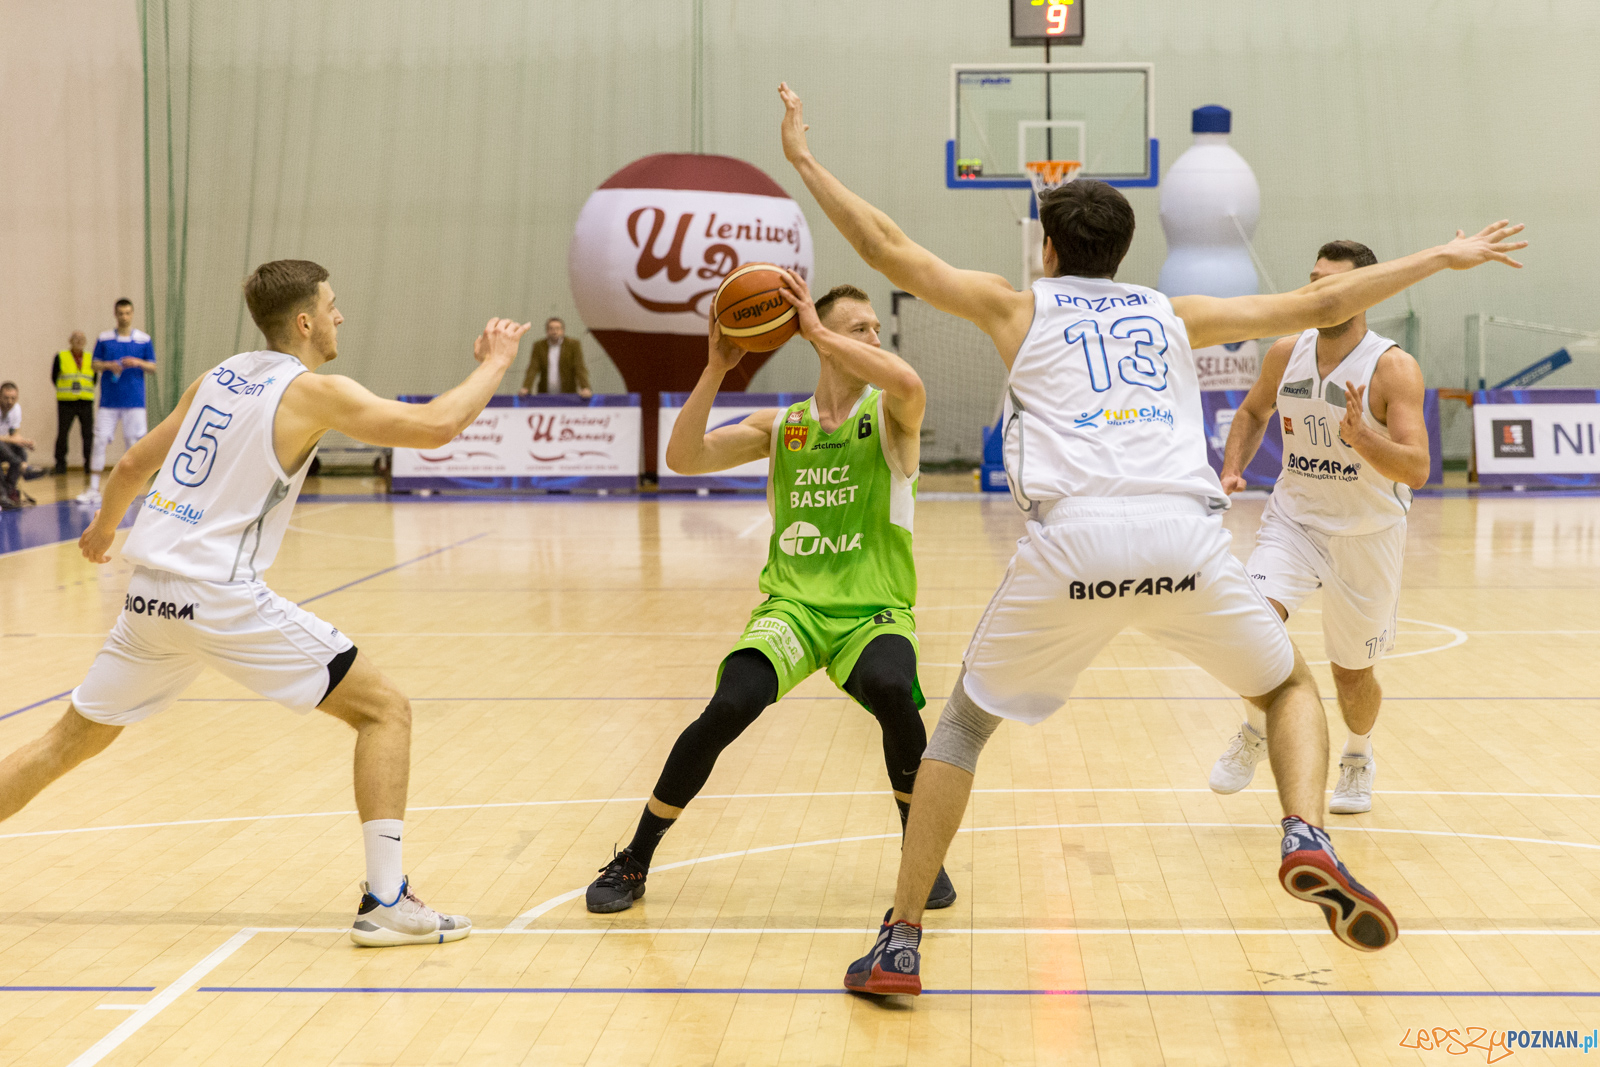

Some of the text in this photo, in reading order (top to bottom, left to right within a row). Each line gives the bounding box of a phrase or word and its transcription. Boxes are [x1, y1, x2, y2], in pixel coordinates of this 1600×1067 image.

[1046, 4, 1068, 34] 9
[627, 207, 801, 283] U leniwej
[733, 294, 784, 322] molten
[1064, 315, 1168, 392] 13
[857, 413, 872, 440] 6
[1103, 405, 1174, 425] funclub
[1303, 414, 1332, 447] 11
[1553, 423, 1600, 455] NI
[173, 404, 233, 488] 5
[794, 465, 850, 486] ZNICZ
[1288, 453, 1358, 475] BIOFARM
[790, 485, 858, 509] BASKET
[796, 532, 862, 556] UNIA
[1069, 573, 1196, 600] BIOFARM
[125, 593, 194, 620] BIOFARM
[757, 620, 787, 635] LOGO
